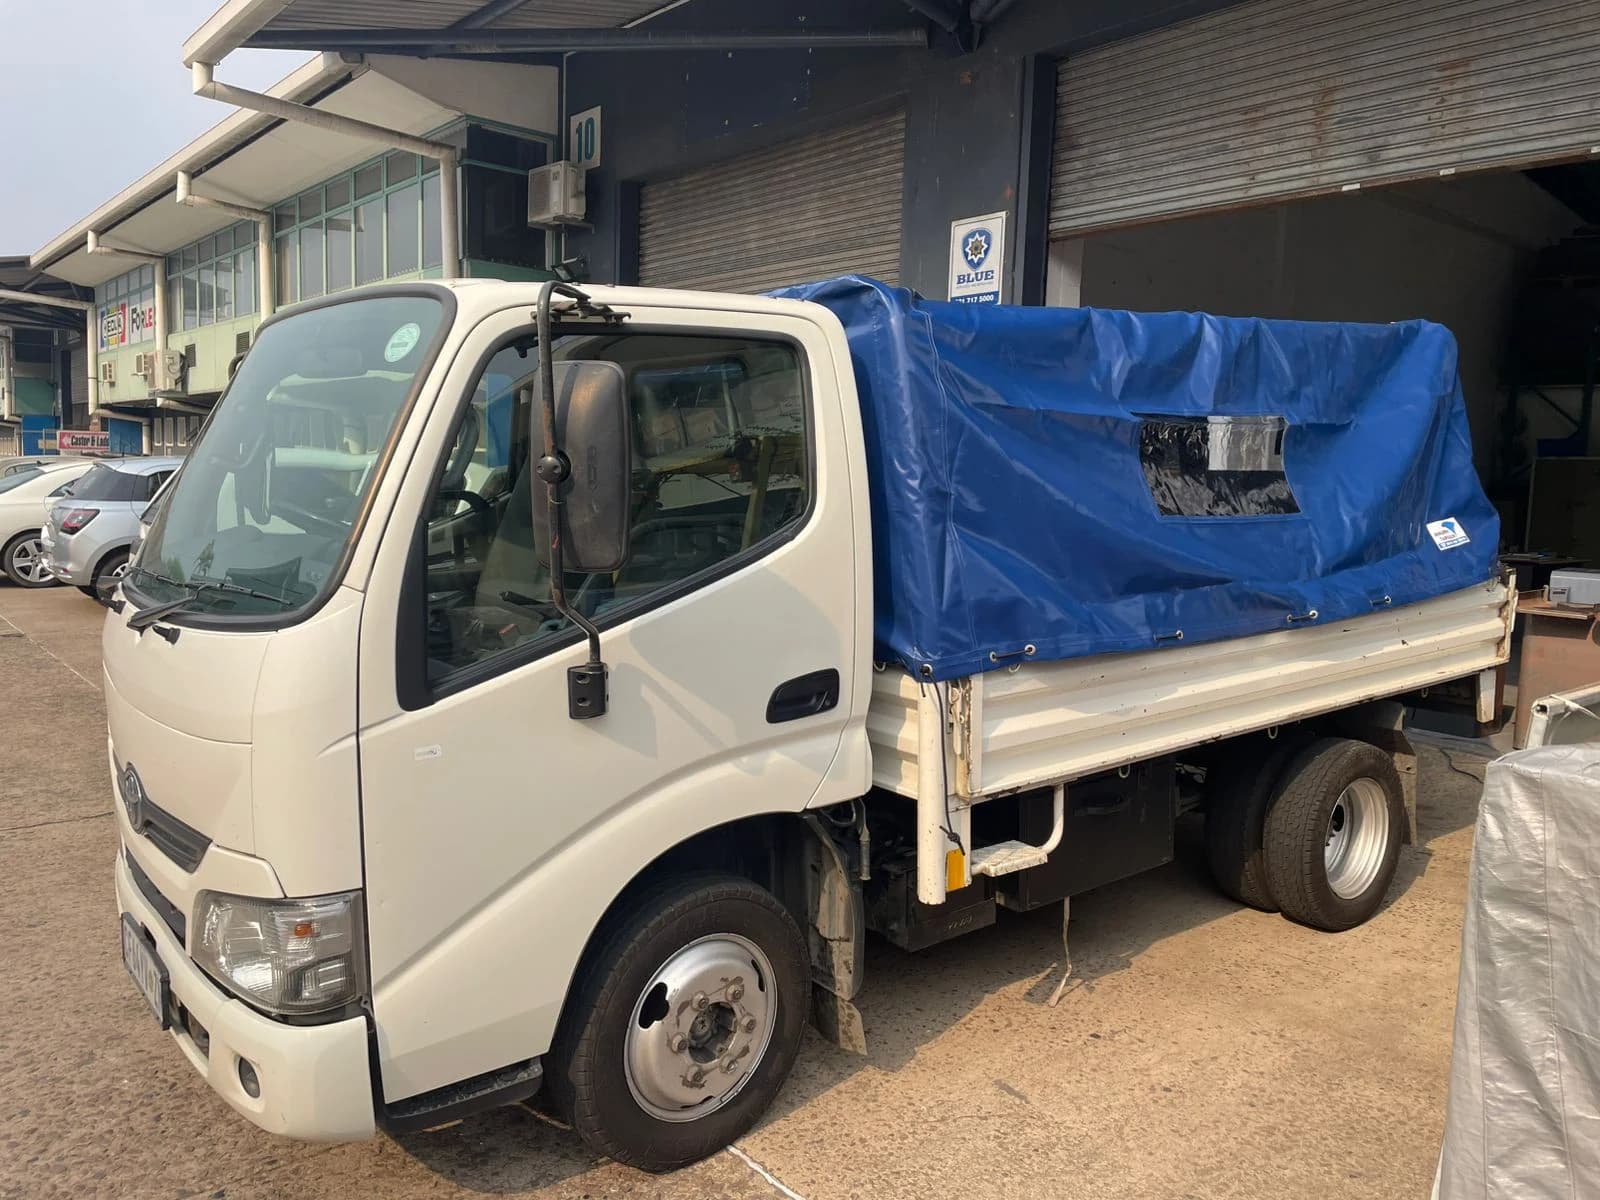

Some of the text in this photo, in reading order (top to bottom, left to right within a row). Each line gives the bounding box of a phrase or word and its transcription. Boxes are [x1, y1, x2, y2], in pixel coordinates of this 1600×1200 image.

[576, 117, 595, 164] 10
[956, 270, 994, 285] BLUE
[979, 294, 995, 303] 5000
